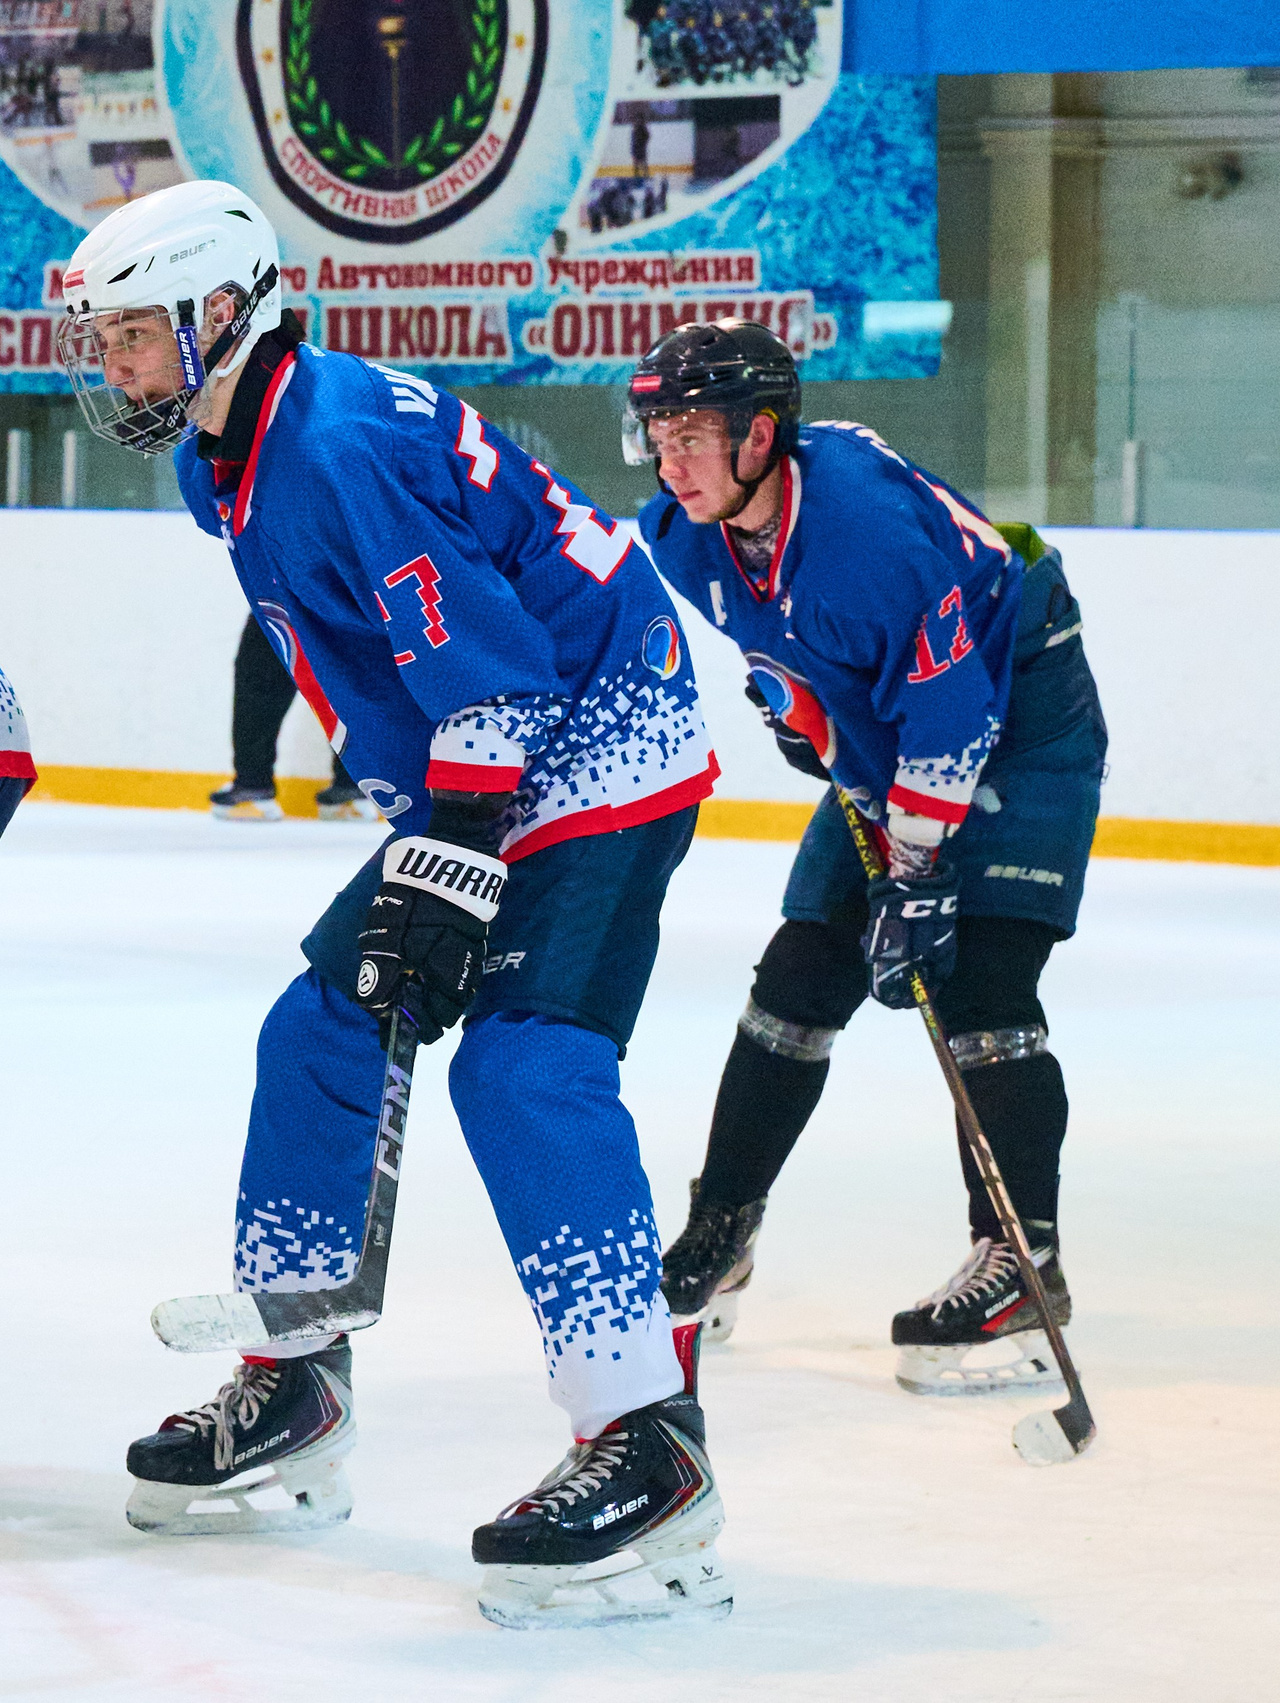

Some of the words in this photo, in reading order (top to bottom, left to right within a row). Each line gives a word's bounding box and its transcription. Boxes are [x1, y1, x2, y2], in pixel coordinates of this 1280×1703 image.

[326, 304, 507, 358] ШКОЛА
[373, 552, 451, 666] 7
[396, 847, 508, 906] WARR
[900, 895, 958, 919] CC
[375, 1063, 413, 1182] CCM
